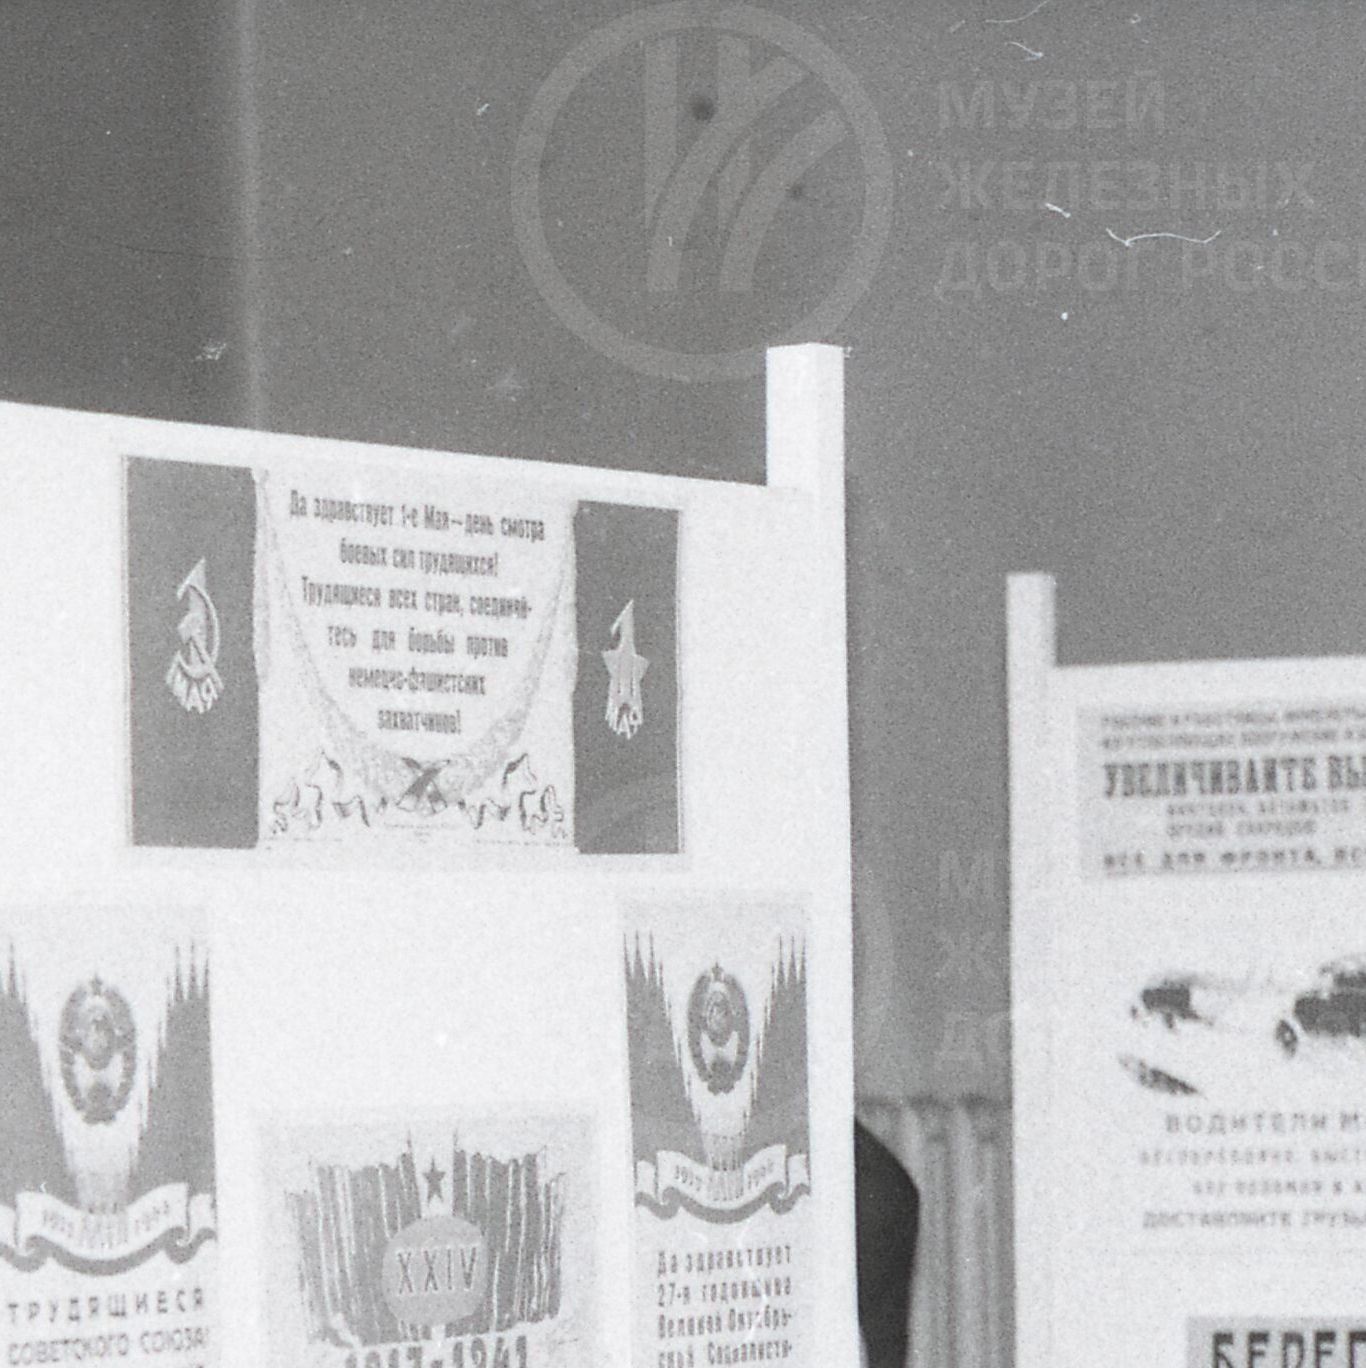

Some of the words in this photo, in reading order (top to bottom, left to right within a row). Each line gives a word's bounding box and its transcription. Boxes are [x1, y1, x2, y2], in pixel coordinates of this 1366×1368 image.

[290, 489, 307, 518] Да
[314, 497, 394, 526] здравствует
[1103, 757, 1317, 799] УВЕЛИЧИВАЙТЕ
[1165, 1113, 1327, 1135] ВОДИТЕЛИ
[398, 1246, 476, 1295] XXIV
